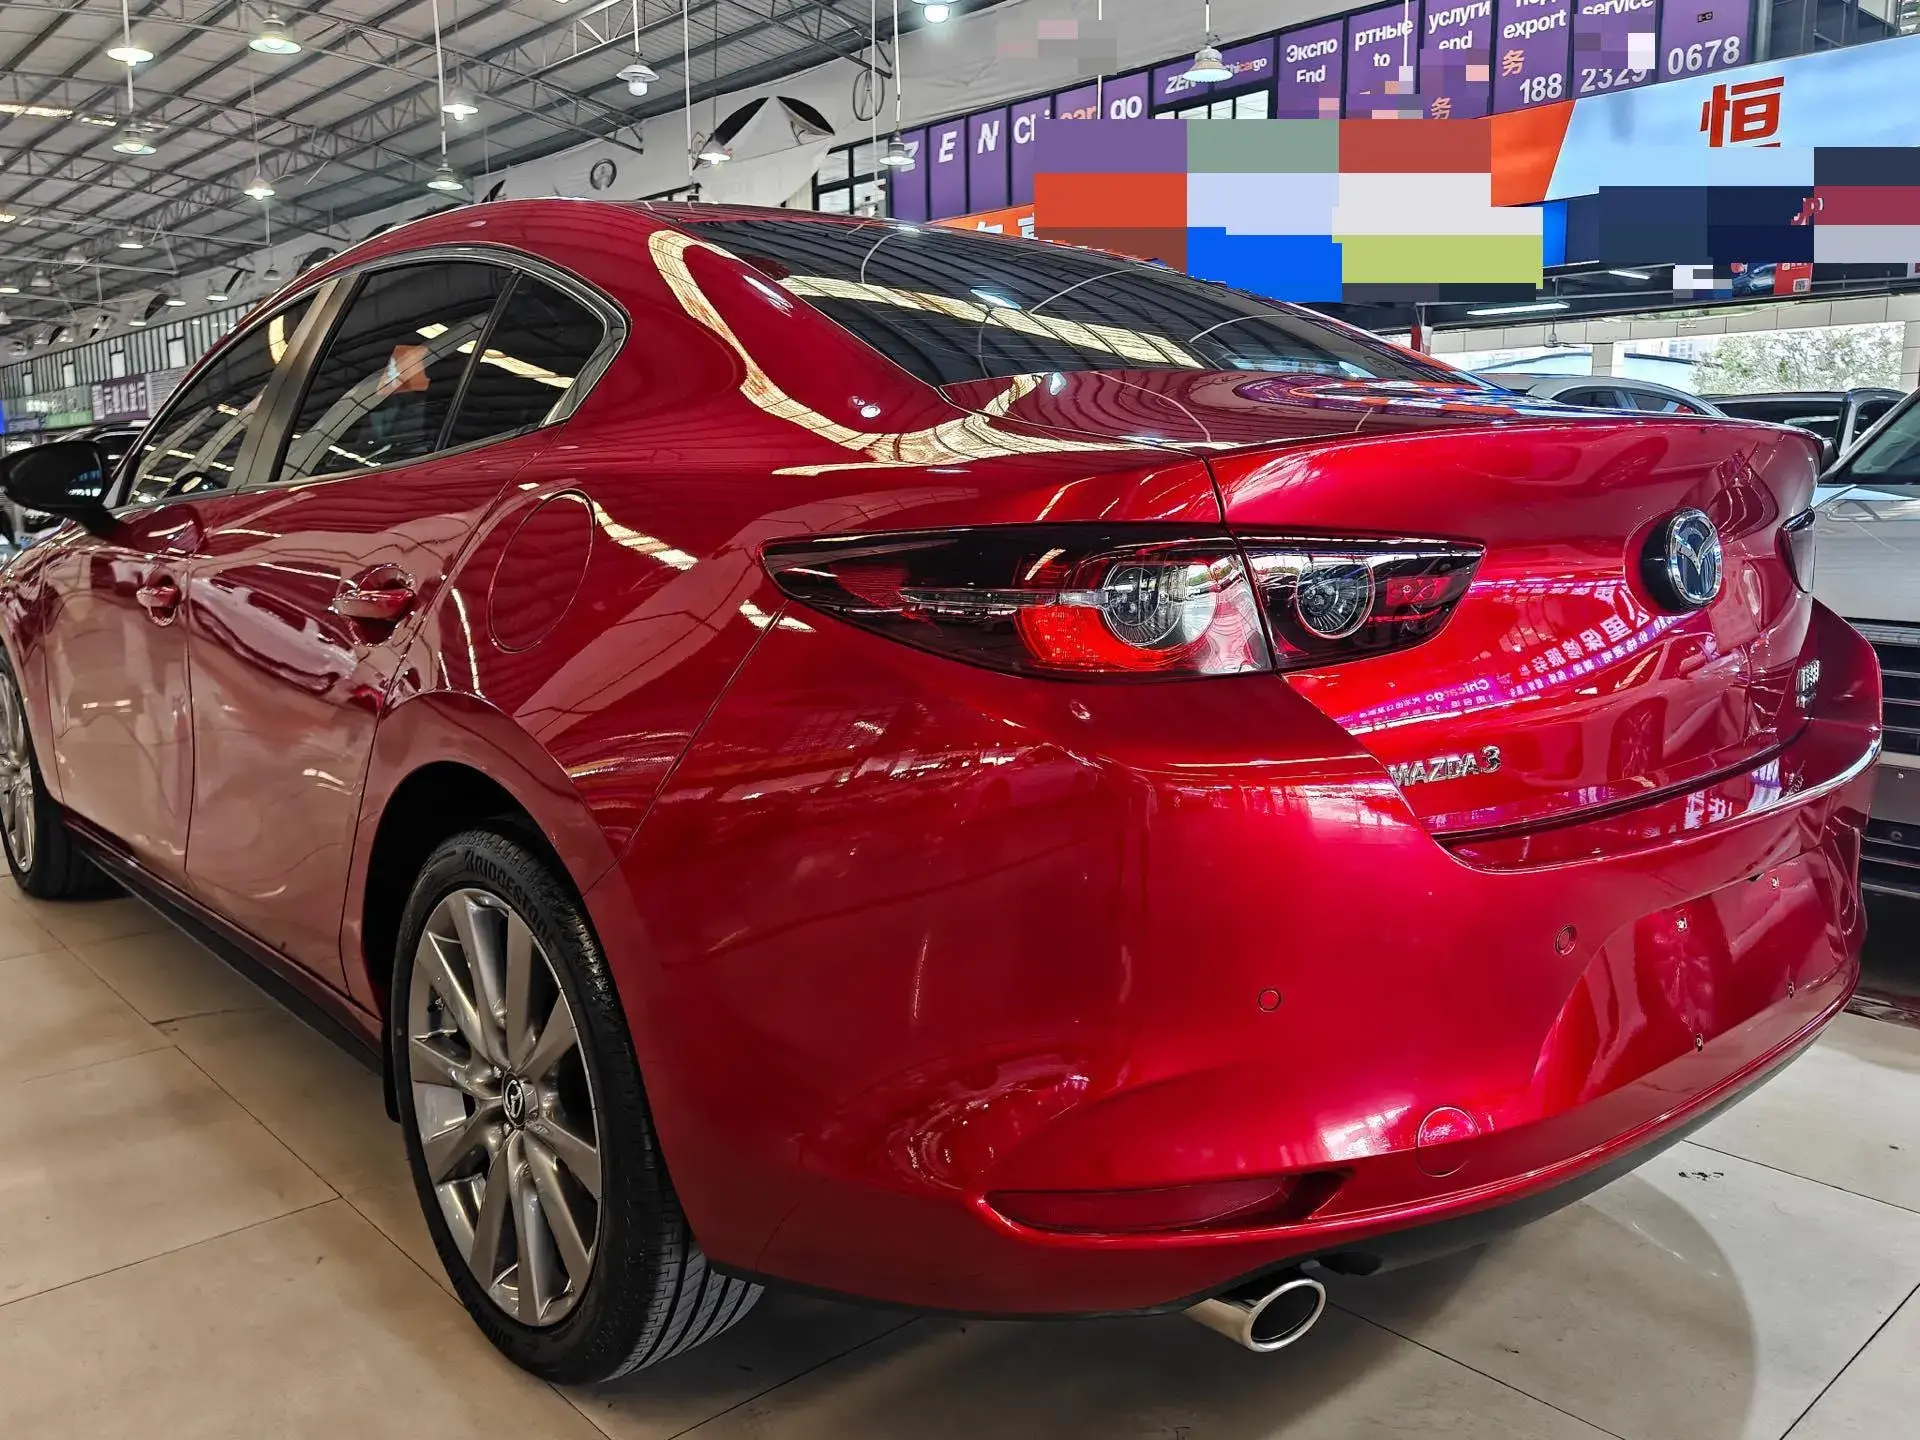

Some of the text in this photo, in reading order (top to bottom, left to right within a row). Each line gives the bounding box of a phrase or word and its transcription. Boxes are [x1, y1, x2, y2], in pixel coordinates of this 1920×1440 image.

[1286, 38, 1338, 64] Экспо
[1428, 0, 1491, 35] услуги
[1373, 52, 1391, 67] to
[1503, 9, 1567, 39] export
[1519, 73, 1563, 104] 188
[1667, 36, 1740, 75] 0678
[1699, 76, 1785, 148] 恒
